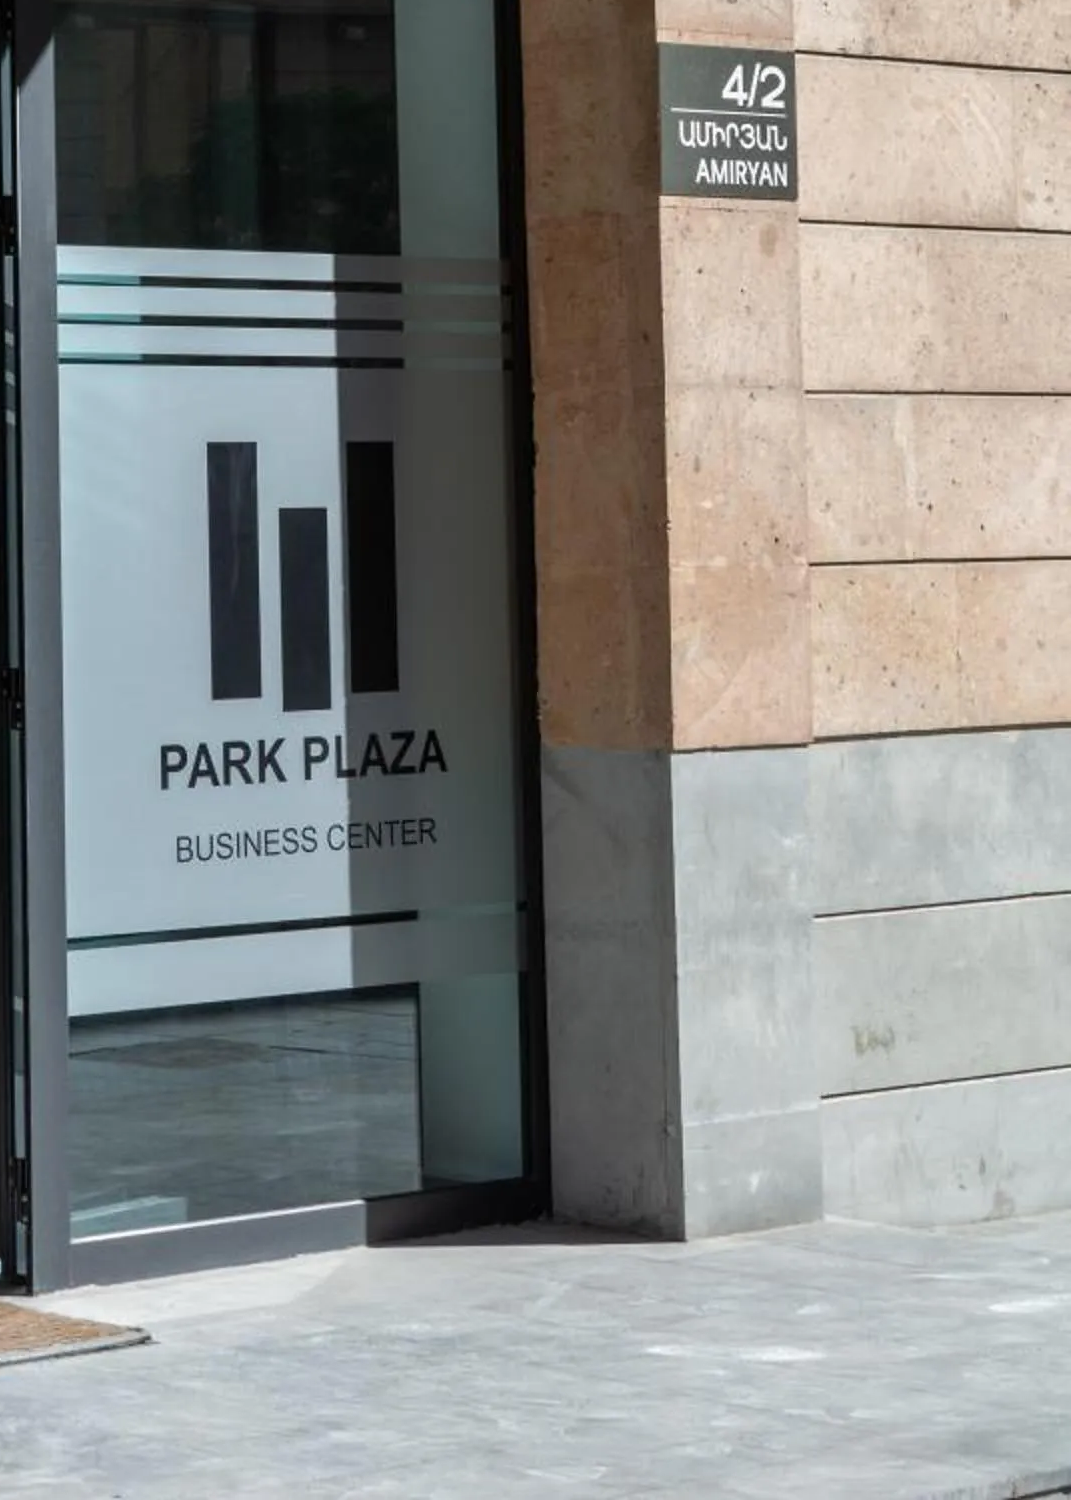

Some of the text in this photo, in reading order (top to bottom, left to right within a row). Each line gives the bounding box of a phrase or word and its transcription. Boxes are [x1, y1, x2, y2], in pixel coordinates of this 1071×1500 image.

[721, 62, 786, 109] 4/2
[679, 120, 788, 151] ԱՄԻՐՅԱՆ
[695, 157, 788, 188] AMIRYAN
[160, 729, 448, 790] PARK PLAZA
[176, 817, 438, 863] BUSINESS CENTER
